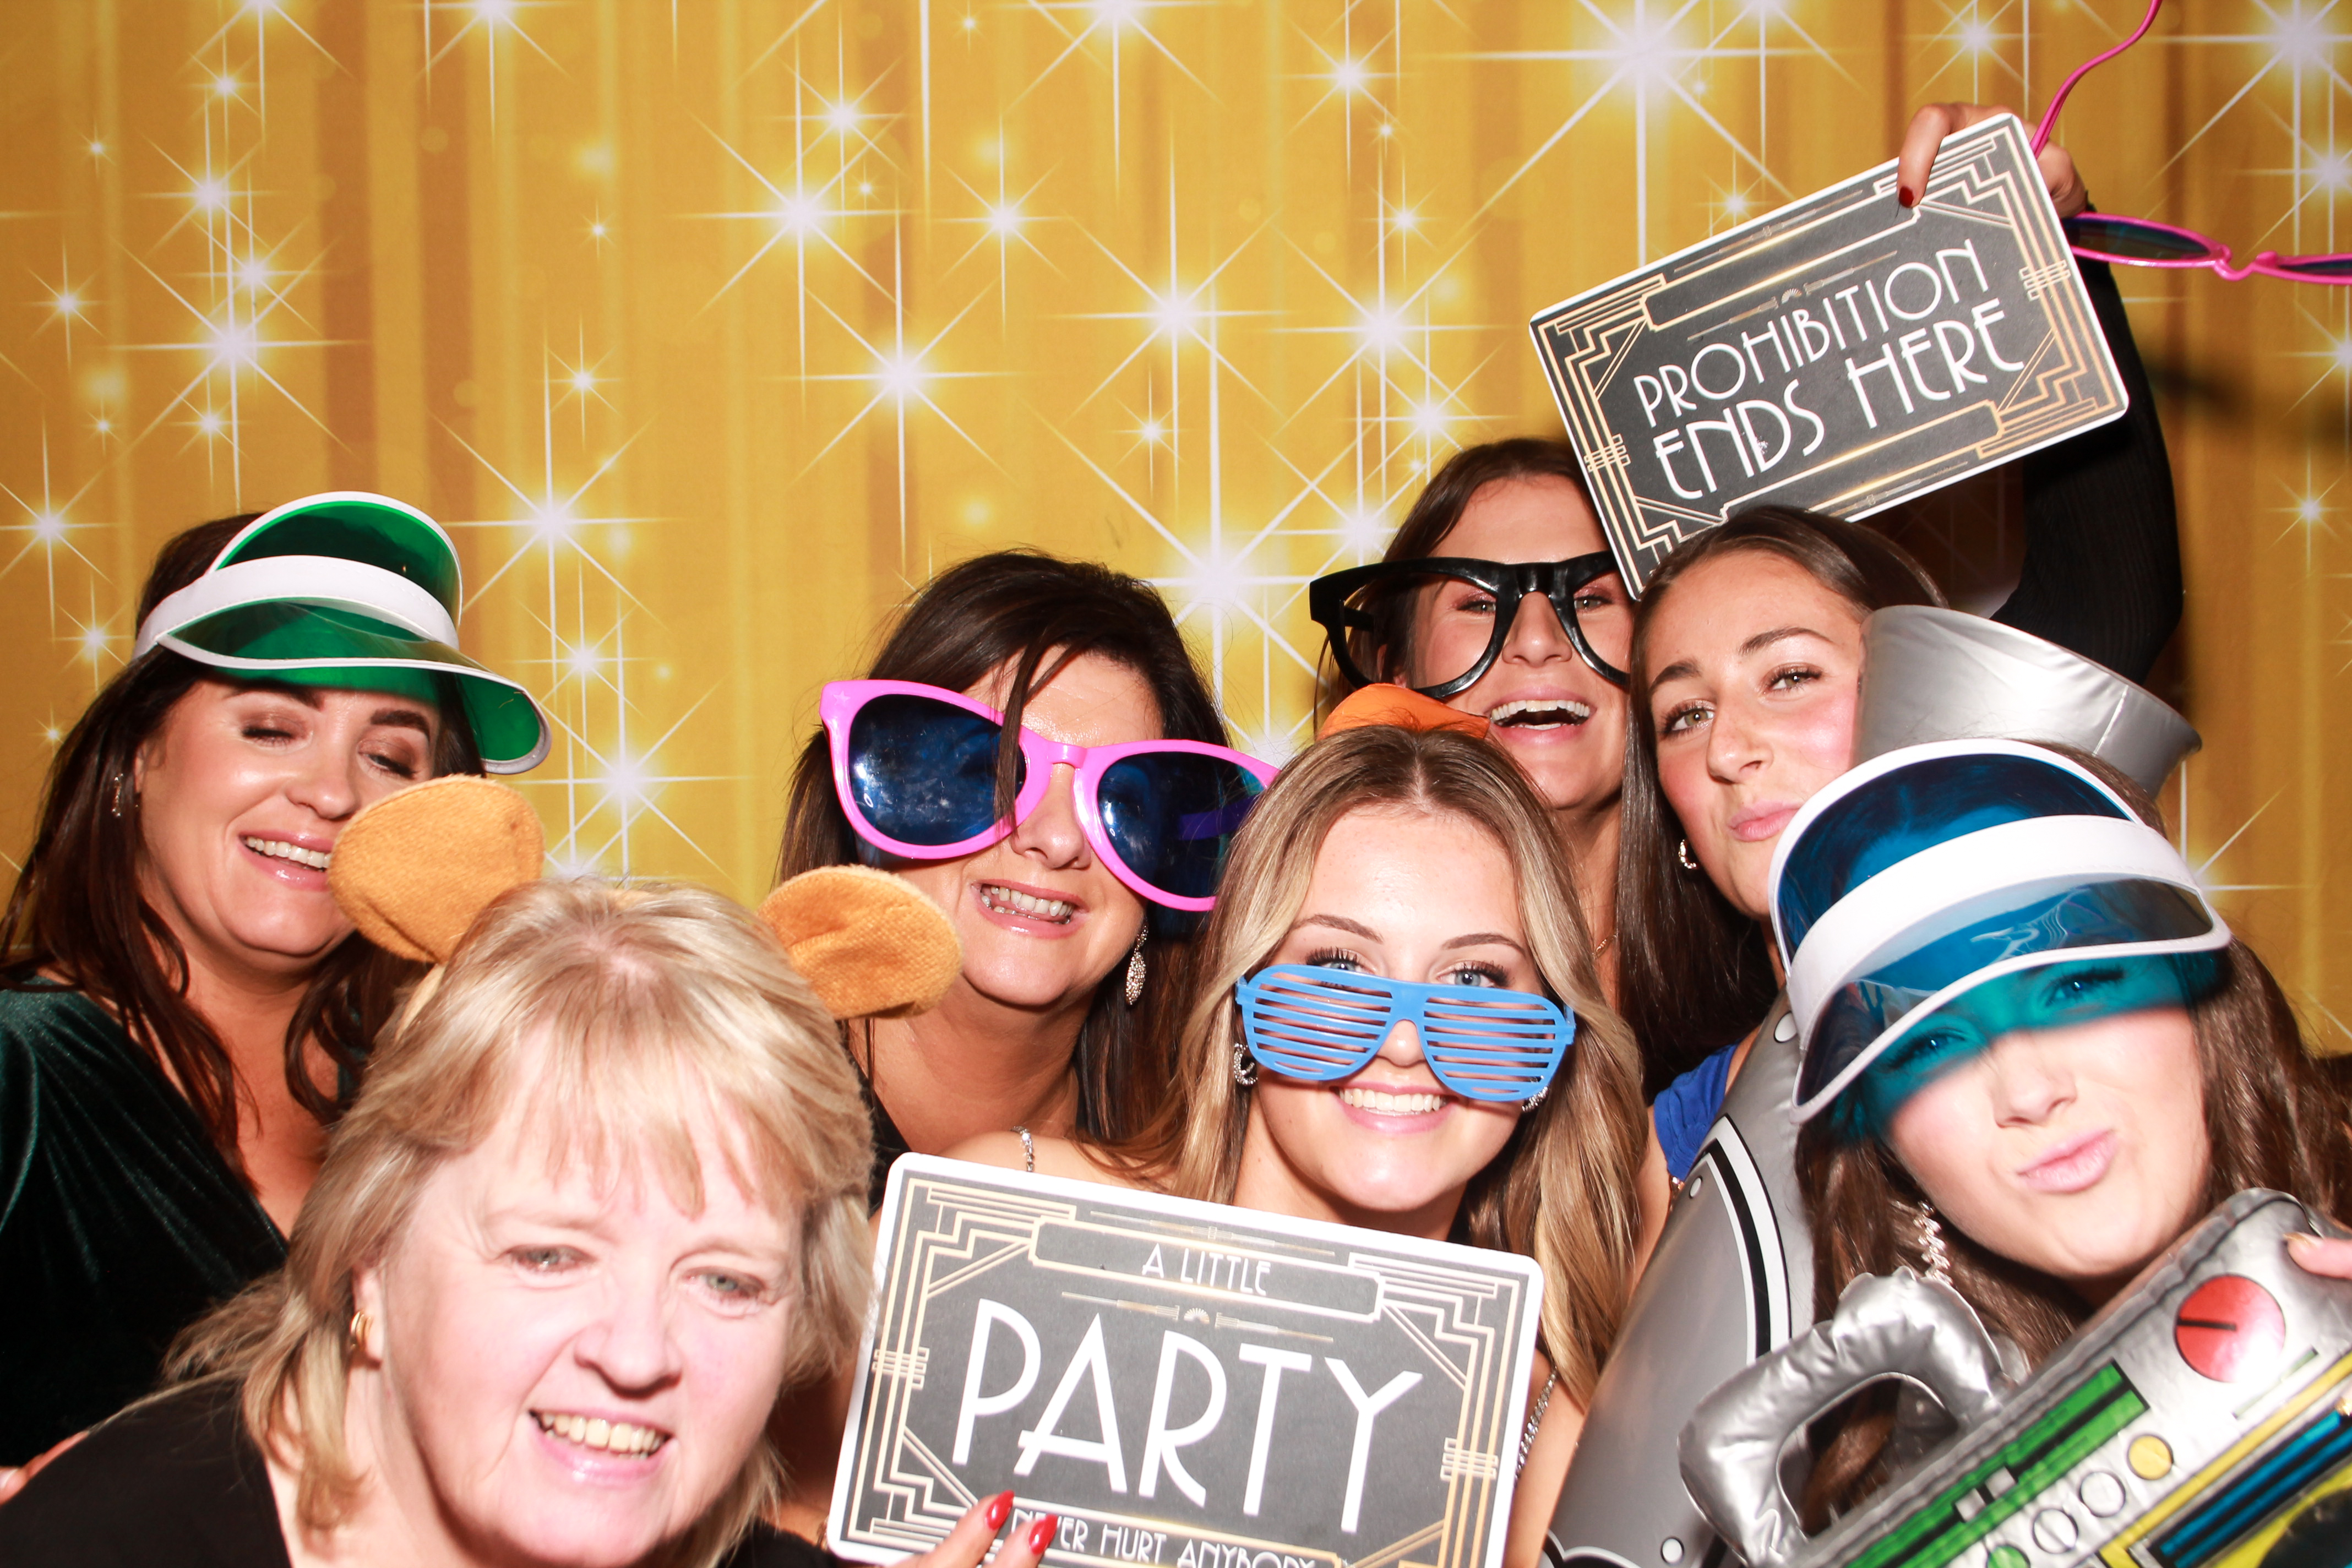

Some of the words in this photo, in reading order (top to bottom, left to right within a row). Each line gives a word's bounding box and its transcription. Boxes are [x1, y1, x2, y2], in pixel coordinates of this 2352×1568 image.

[1634, 238, 1989, 428] PROHIBITION
[1652, 379, 1825, 499] ENDS
[1844, 298, 2024, 428] HERE
[1142, 1243, 1164, 1278] A
[1180, 1248, 1271, 1296] LITTLE
[952, 1298, 1423, 1533] PARTY
[1011, 1508, 1088, 1552] NER
[1101, 1523, 1167, 1562] HURT
